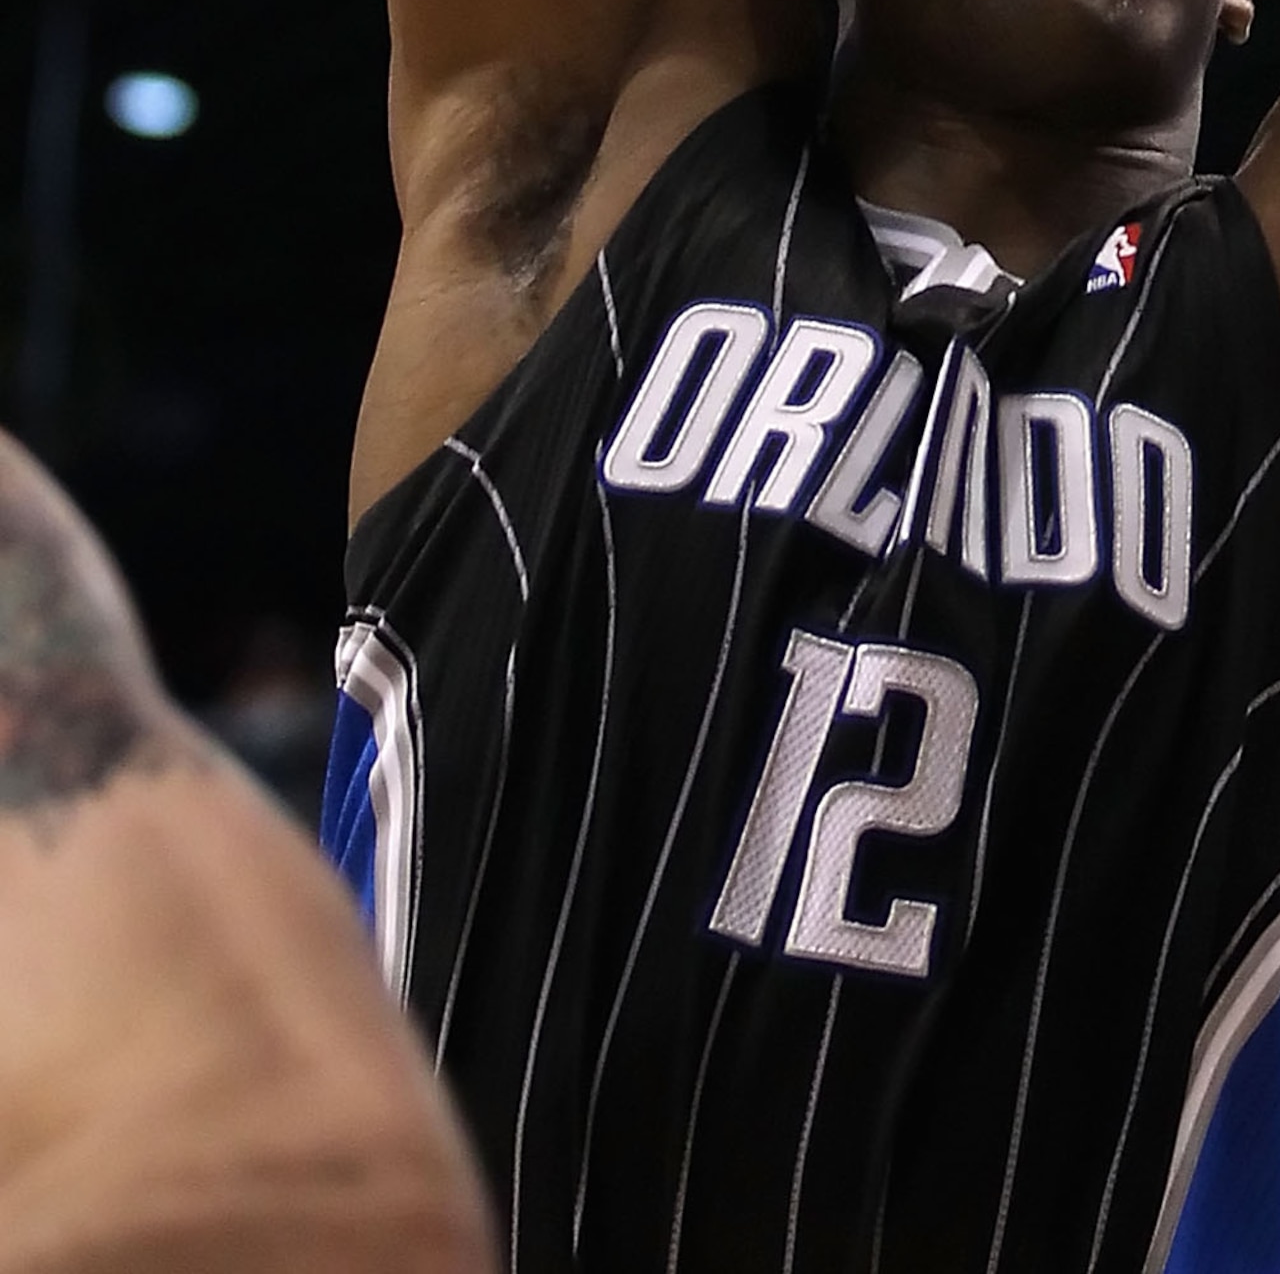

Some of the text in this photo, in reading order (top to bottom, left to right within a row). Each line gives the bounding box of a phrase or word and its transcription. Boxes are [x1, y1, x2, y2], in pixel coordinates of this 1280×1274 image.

[1086, 271, 1118, 293] NBA
[600, 301, 1193, 632] ORLNDO
[709, 628, 979, 976] 12
